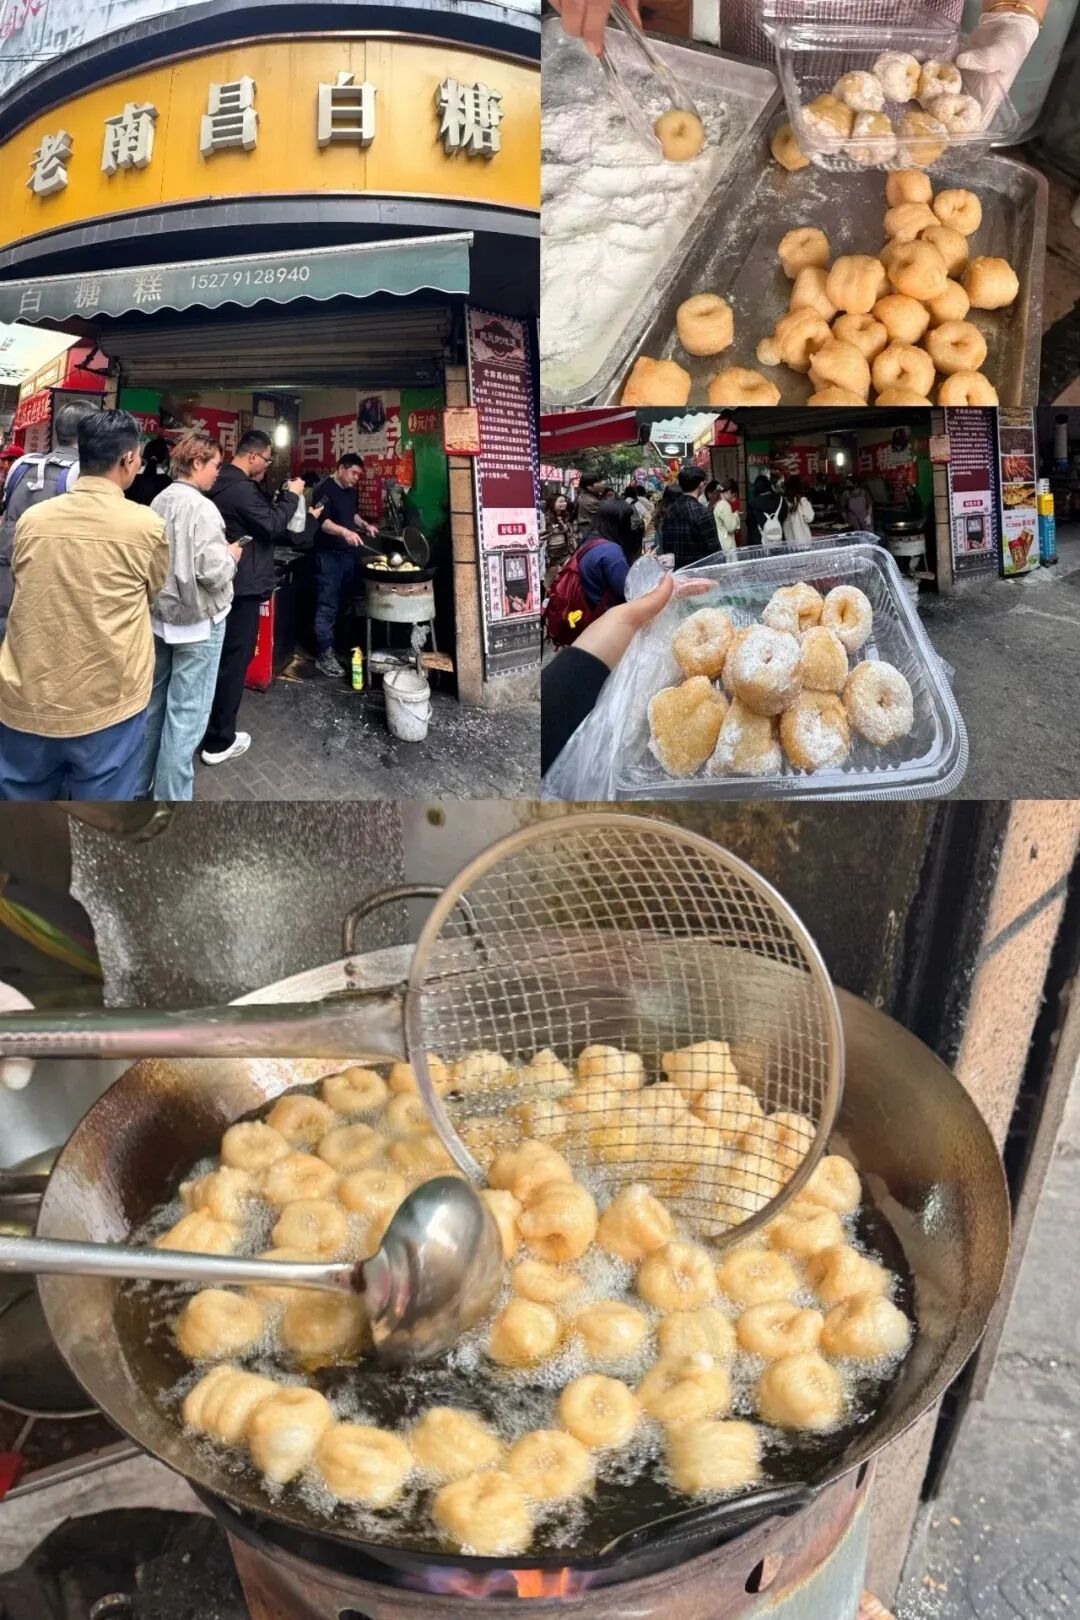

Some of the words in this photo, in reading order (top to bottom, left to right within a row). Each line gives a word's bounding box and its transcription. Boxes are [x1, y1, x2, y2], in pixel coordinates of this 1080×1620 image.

[25, 71, 504, 197] 老南昌白糖
[18, 274, 163, 314] 白糖糕
[190, 265, 311, 290] 15279128940
